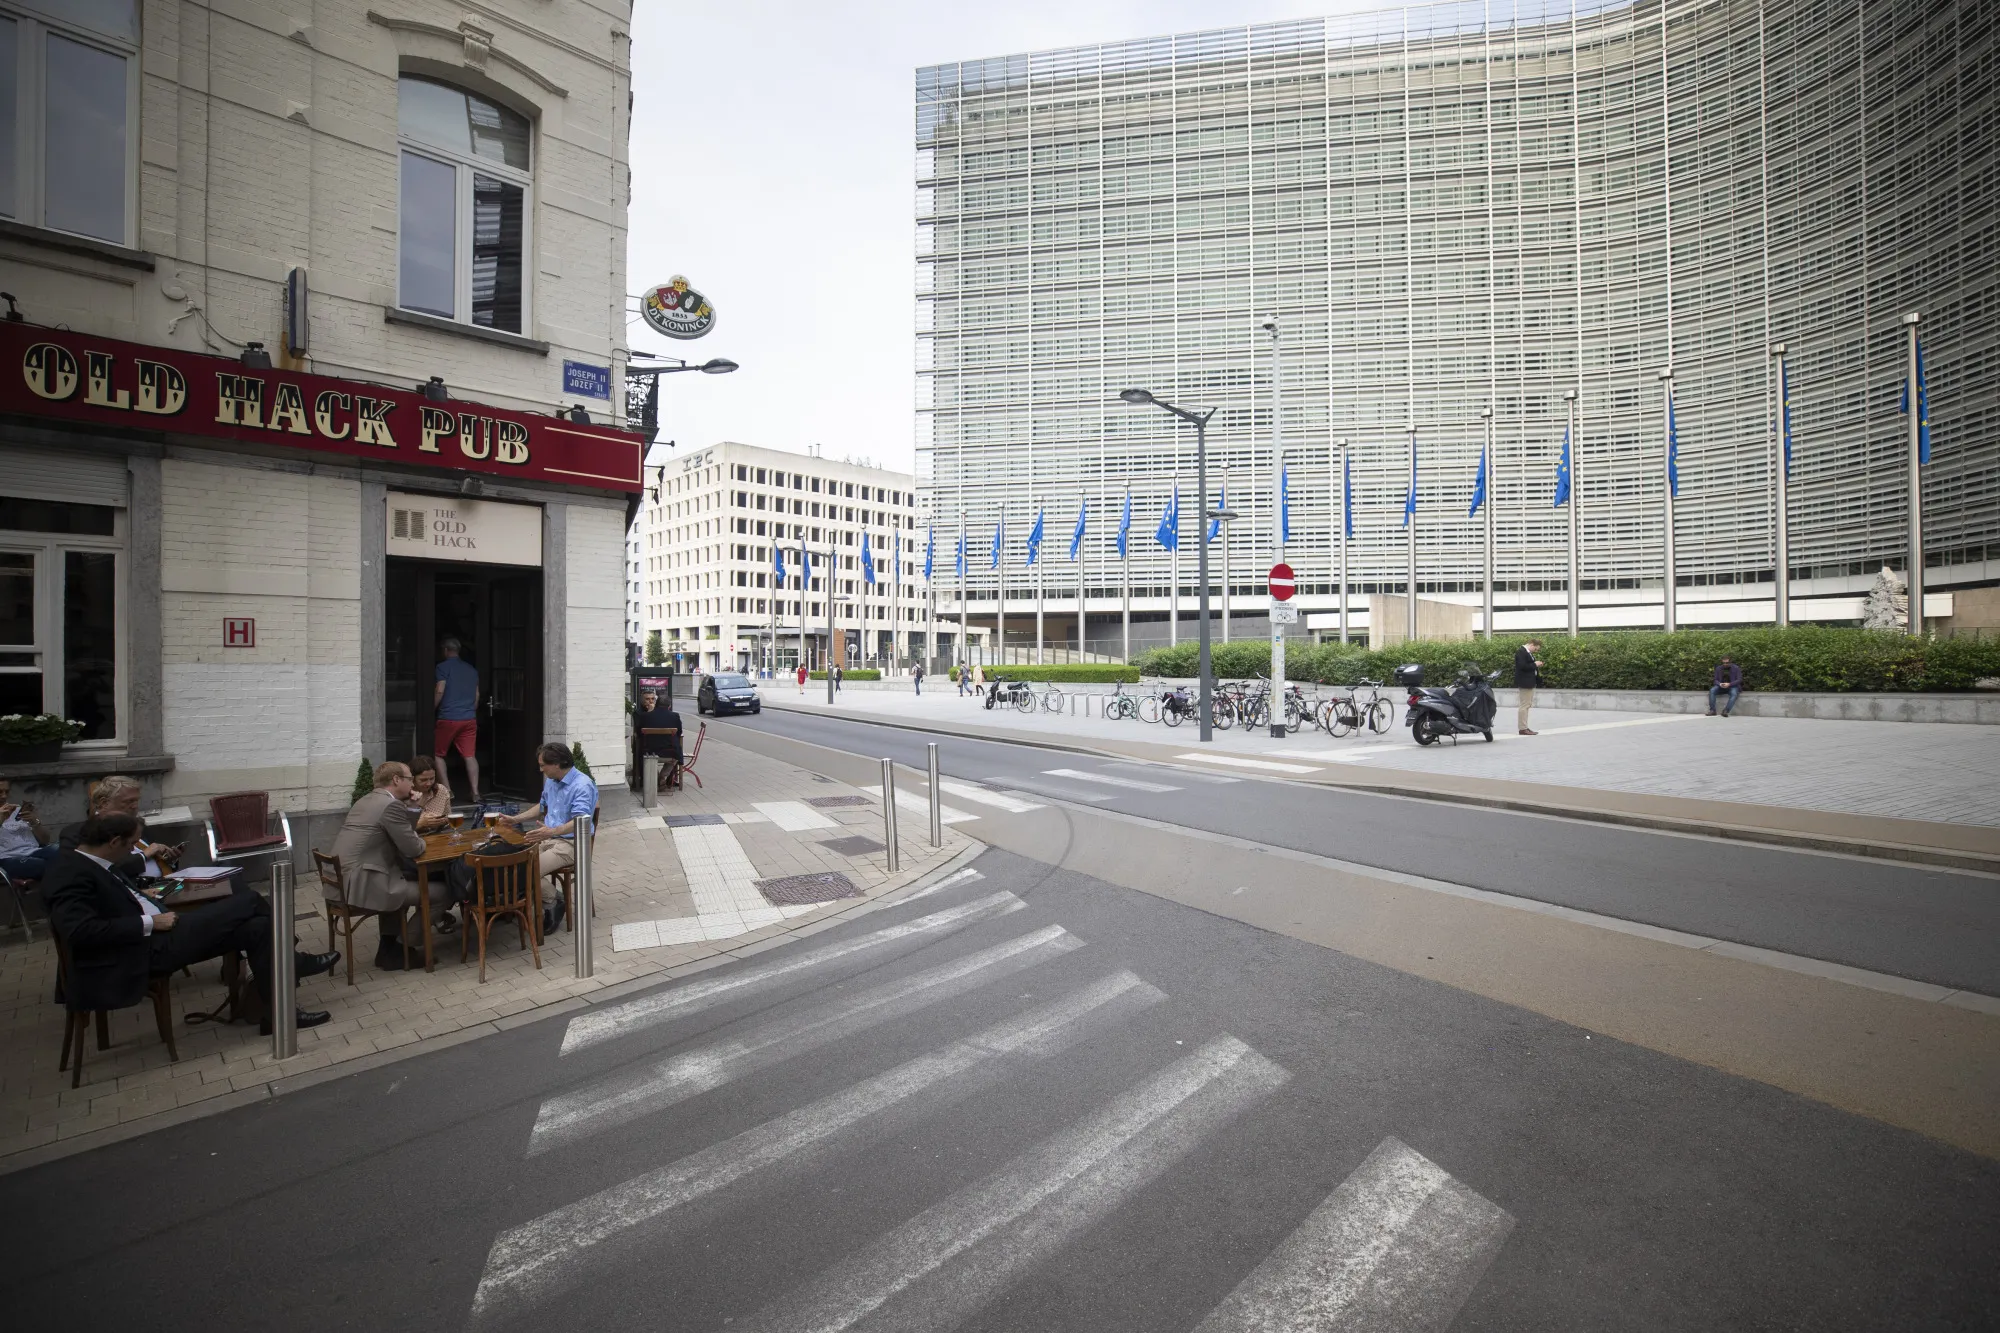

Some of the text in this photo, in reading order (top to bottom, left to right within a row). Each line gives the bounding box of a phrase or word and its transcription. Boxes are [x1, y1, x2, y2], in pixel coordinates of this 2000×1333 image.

[649, 307, 710, 332] DE KONINCK
[567, 367, 606, 383] JOSEPH II
[570, 378, 603, 392] JOZEF II
[23, 342, 530, 464] OLD HACK PUB
[682, 450, 713, 472] IPC
[433, 508, 457, 519] THE
[433, 520, 467, 534] OLD
[433, 534, 477, 549] HACK
[229, 621, 249, 644] H
